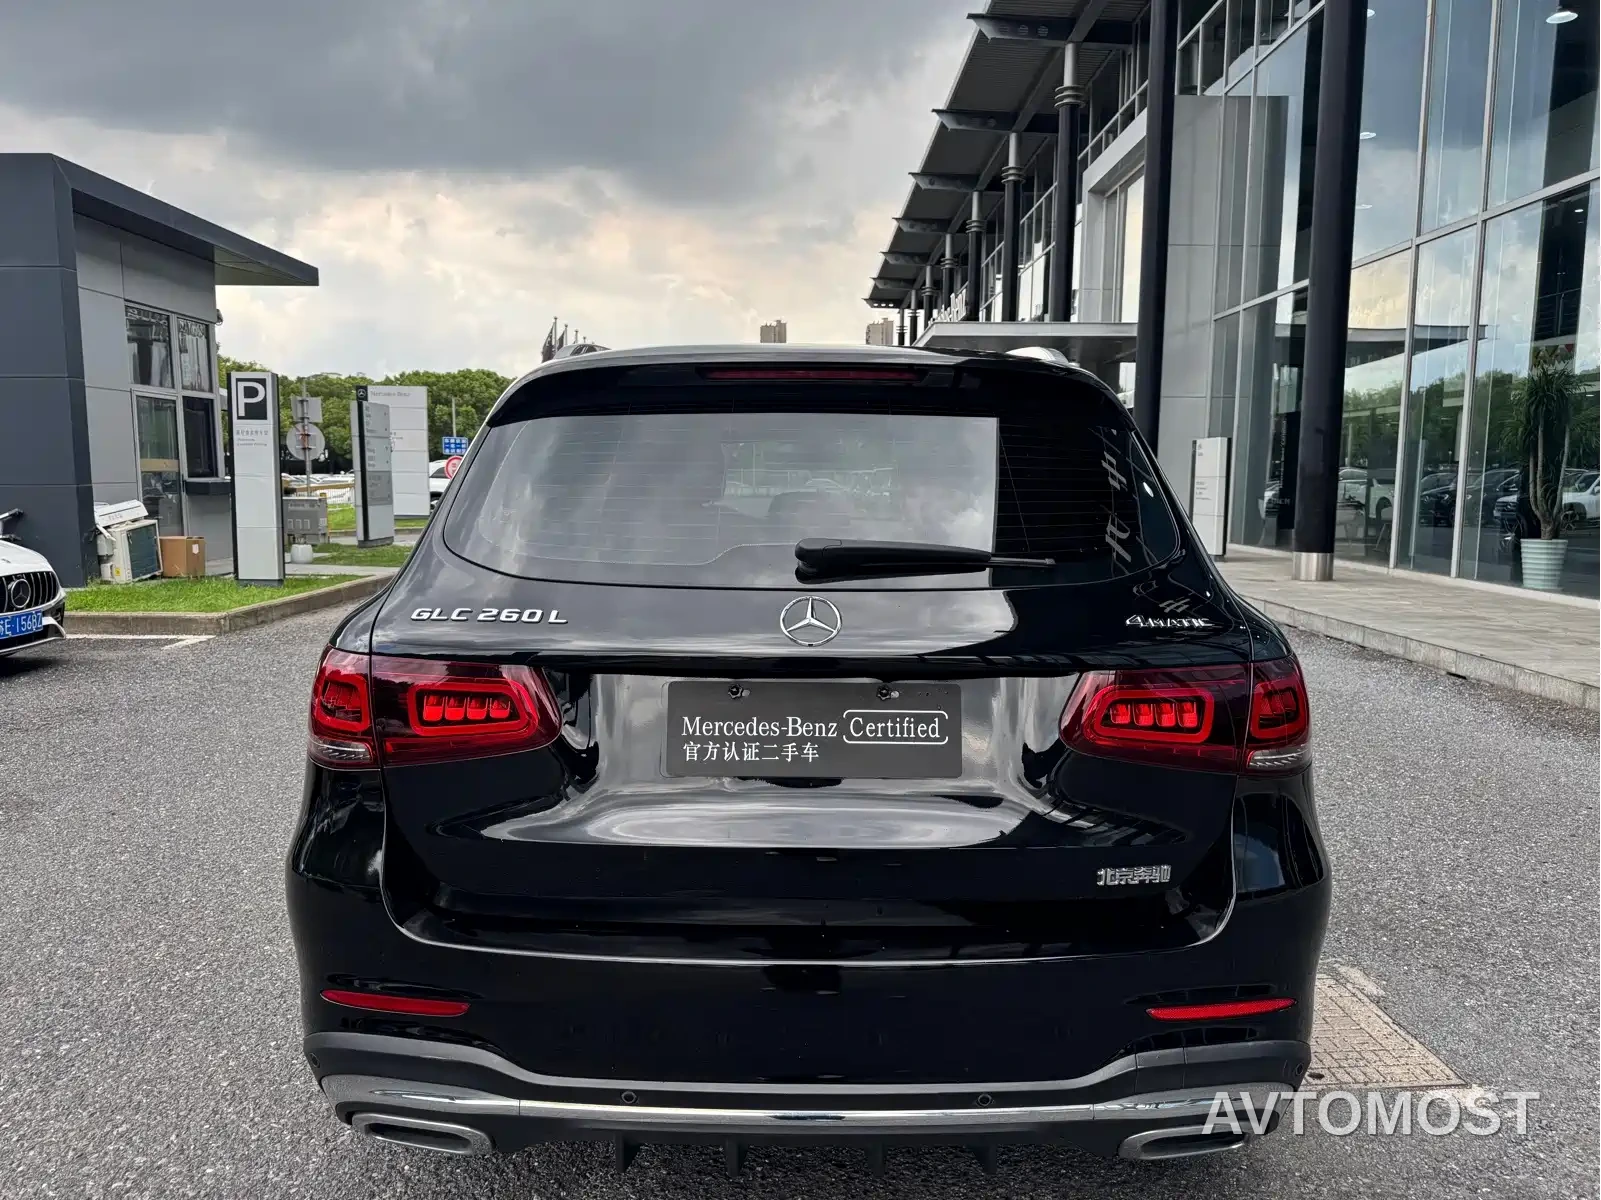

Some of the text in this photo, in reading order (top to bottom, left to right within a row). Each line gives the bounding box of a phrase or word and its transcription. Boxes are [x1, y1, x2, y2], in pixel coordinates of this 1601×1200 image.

[237, 381, 266, 417] P
[410, 607, 569, 624] GLC 260 L
[1125, 614, 1214, 629] 4MATIC
[681, 716, 941, 739] Mercedes-Benz Certified
[683, 741, 819, 763] 官方认证二手车
[1096, 865, 1172, 886] 北京奔驰
